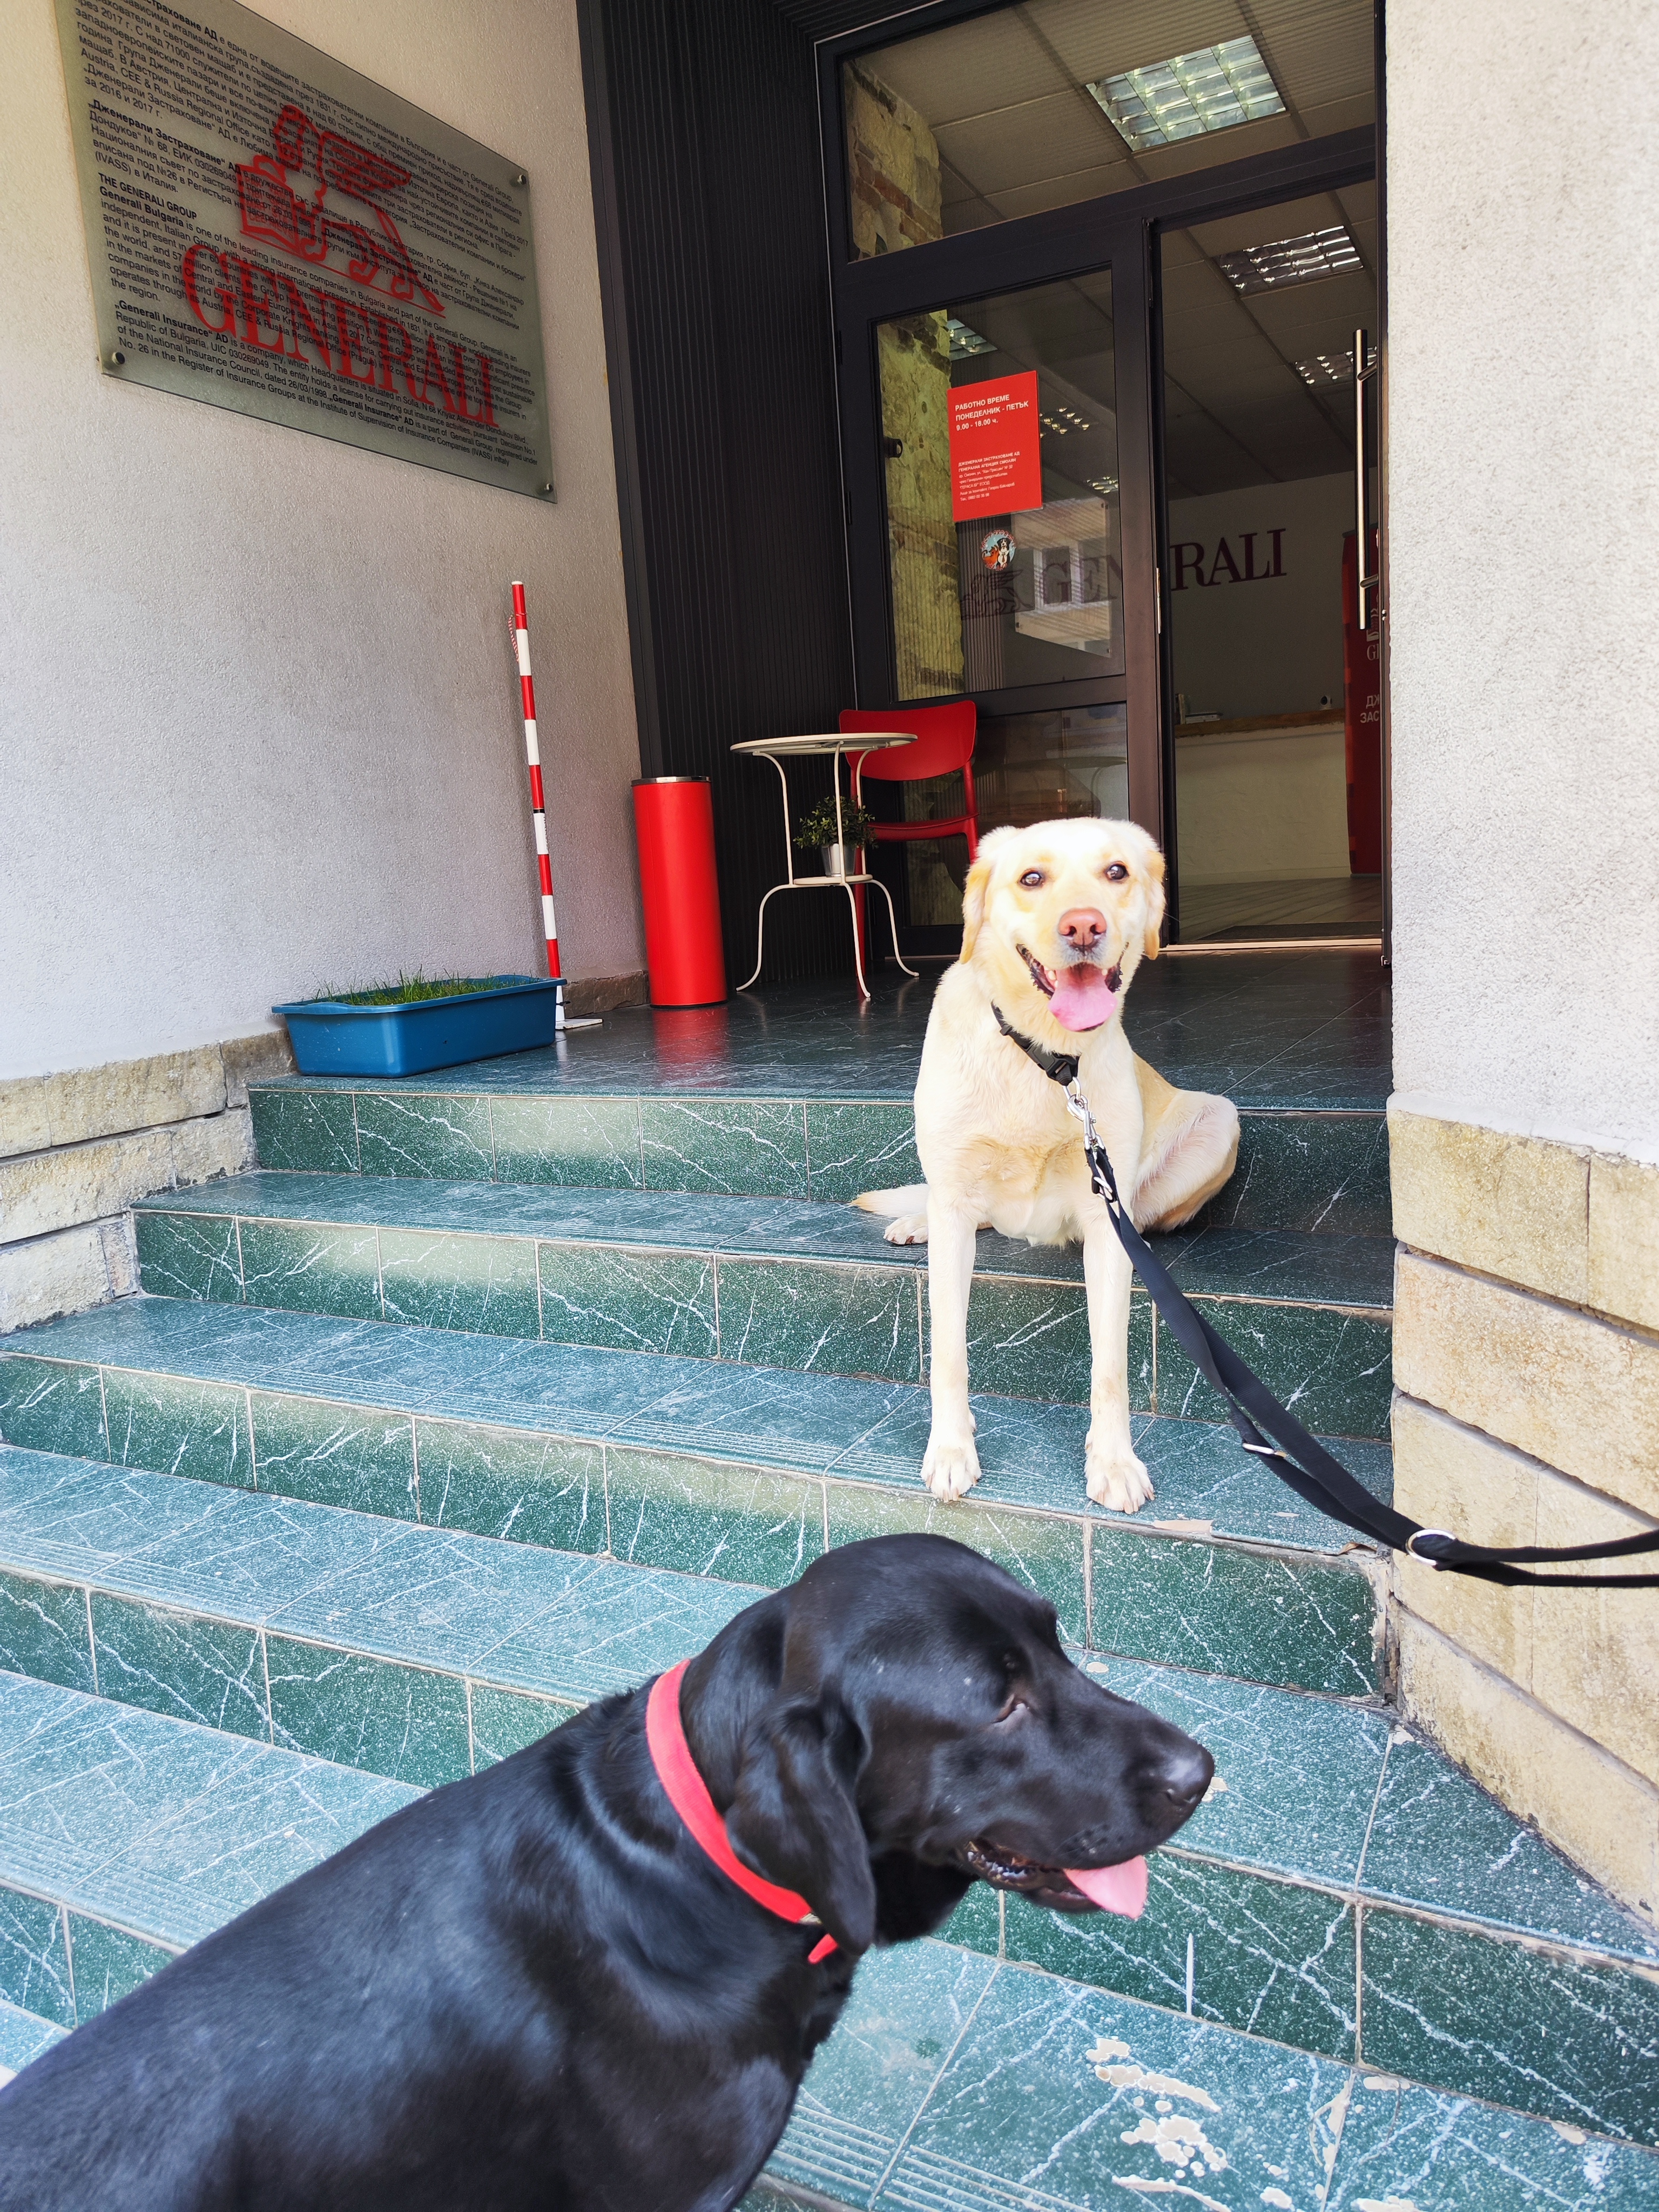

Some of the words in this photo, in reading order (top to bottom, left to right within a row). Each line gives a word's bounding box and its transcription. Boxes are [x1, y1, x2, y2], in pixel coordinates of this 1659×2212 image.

[75, 8, 184, 70] западноевропейските
[186, 65, 219, 87] пазари
[221, 83, 226, 91] и
[228, 87, 244, 100] все
[100, 7, 123, 24] 2017
[135, 25, 143, 36] С
[145, 32, 164, 48] над
[165, 40, 190, 60] 71000
[192, 57, 239, 86] служители
[154, 24, 160, 33] в
[163, 29, 205, 57] световен
[207, 53, 236, 73] мащаб
[204, 26, 218, 43] АД
[227, 41, 247, 57] една
[249, 53, 258, 62] от
[118, 40, 146, 63] Група
[149, 56, 202, 91] Дженерали
[204, 85, 227, 103] беше
[229, 99, 269, 125] включена
[172, 22, 224, 56] италианска
[295, 89, 314, 104] през
[316, 99, 331, 113] 1831
[84, 76, 97, 89] за
[99, 82, 122, 99] 2016
[124, 95, 130, 104] и
[132, 97, 153, 113] 2017
[119, 53, 127, 65] В
[173, 80, 222, 112] Централна
[224, 108, 230, 116] и
[232, 110, 267, 134] Източна
[120, 67, 141, 85] CEE
[144, 78, 151, 89] &
[153, 83, 184, 105] Russia
[186, 98, 224, 124] Regional
[225, 119, 249, 137] Office
[252, 133, 270, 146] като
[218, 126, 231, 141] АД
[240, 137, 273, 160] Любима
[92, 138, 134, 163] вписана
[137, 158, 155, 173] под
[179, 176, 185, 184] в
[187, 177, 232, 205] Регистъра
[95, 150, 131, 175] (IVASS)
[134, 169, 140, 177] в
[172, 147, 193, 164] ЕИК
[194, 158, 237, 184] 030269049
[228, 161, 241, 176] АД
[90, 123, 157, 160] Националния
[159, 156, 185, 172] съвет
[187, 168, 199, 178] по
[439, 281, 453, 291] част
[98, 172, 117, 188] THE
[119, 181, 164, 207] GENERALI
[166, 201, 197, 220] GROUP
[99, 185, 141, 210] Generali
[144, 203, 184, 227] Bulgaria
[185, 220, 193, 231] is
[195, 226, 212, 238] one
[214, 233, 222, 242] of
[224, 237, 237, 248] the
[239, 242, 268, 263] leading
[270, 255, 307, 277] insurance
[309, 273, 348, 293] companies
[103, 213, 122, 227] and
[123, 220, 130, 230] it
[131, 222, 140, 233] is
[142, 229, 177, 248] present
[178, 242, 186, 252] in
[104, 225, 119, 238] the
[153, 245, 170, 257] and
[172, 251, 182, 261] 57
[164, 223, 191, 241] Italian
[106, 237, 115, 249] in
[117, 242, 132, 255] the
[134, 250, 171, 269] markets
[173, 264, 183, 274] of
[107, 253, 159, 277] companies
[161, 270, 170, 281] in
[172, 274, 186, 287] the
[109, 266, 151, 286] operates
[152, 279, 188, 302] through
[110, 277, 126, 289] the
[115, 310, 156, 332] Republic
[159, 326, 167, 335] of
[211, 341, 226, 354] UIC
[181, 244, 499, 428] GENERALI
[214, 332, 228, 343] AD
[230, 336, 238, 347] is
[117, 326, 126, 335] of
[129, 328, 144, 340] the
[146, 333, 183, 353] National
[185, 345, 227, 366] Insurance
[264, 372, 286, 385] dated
[403, 416, 414, 426] AD
[138, 342, 149, 354] 26
[151, 346, 159, 358] in
[161, 350, 176, 362] the
[178, 355, 213, 373] Register
[215, 368, 224, 377] of
[226, 370, 266, 389] Insurance
[955, 399, 986, 412] РАБОТНО
[987, 394, 1010, 404] ВРЕМЕ
[955, 407, 1001, 422] ПОНЕДЕЛНИК
[1006, 401, 1029, 411] ПЕТЪК
[956, 422, 969, 431] 9.00
[975, 419, 990, 427] 18.00
